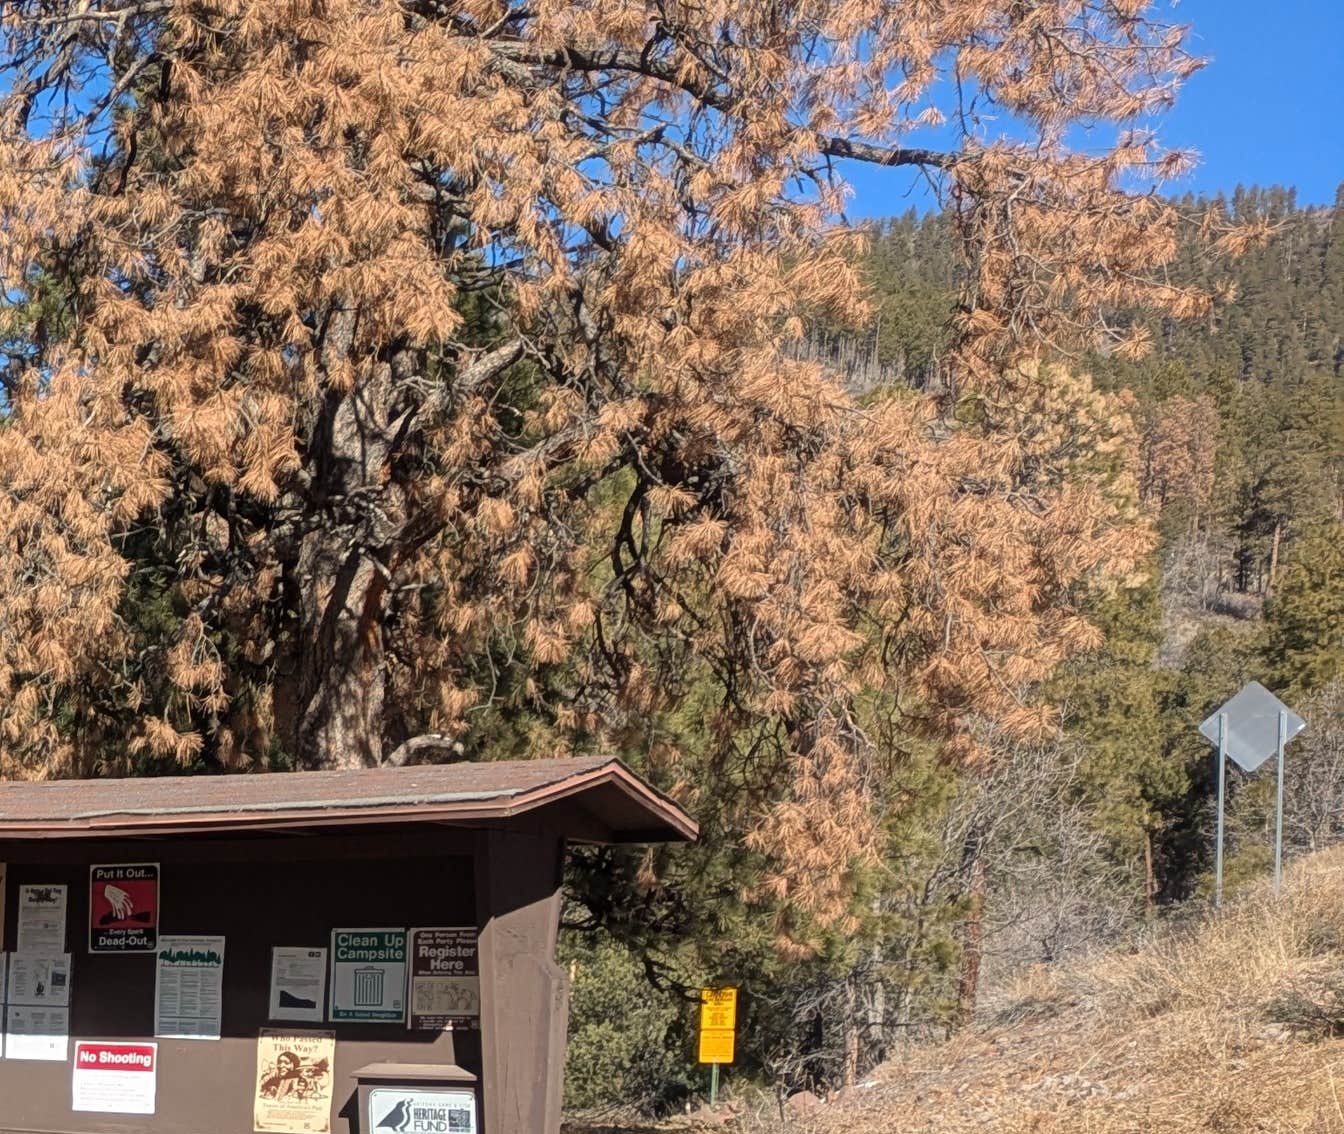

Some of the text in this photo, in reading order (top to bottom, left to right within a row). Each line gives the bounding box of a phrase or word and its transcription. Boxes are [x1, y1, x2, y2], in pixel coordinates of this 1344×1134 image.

[97, 868, 154, 879] Put It Out...
[99, 936, 148, 946] Dead-Out
[338, 934, 404, 949] Clean Up
[337, 947, 404, 961] Campsite
[419, 945, 476, 960] Register
[430, 959, 464, 970] Here
[273, 1043, 318, 1054] This Way?
[80, 1051, 152, 1067] No Shooting
[414, 1108, 447, 1121] HERITAGE
[414, 1121, 447, 1132] FUND
